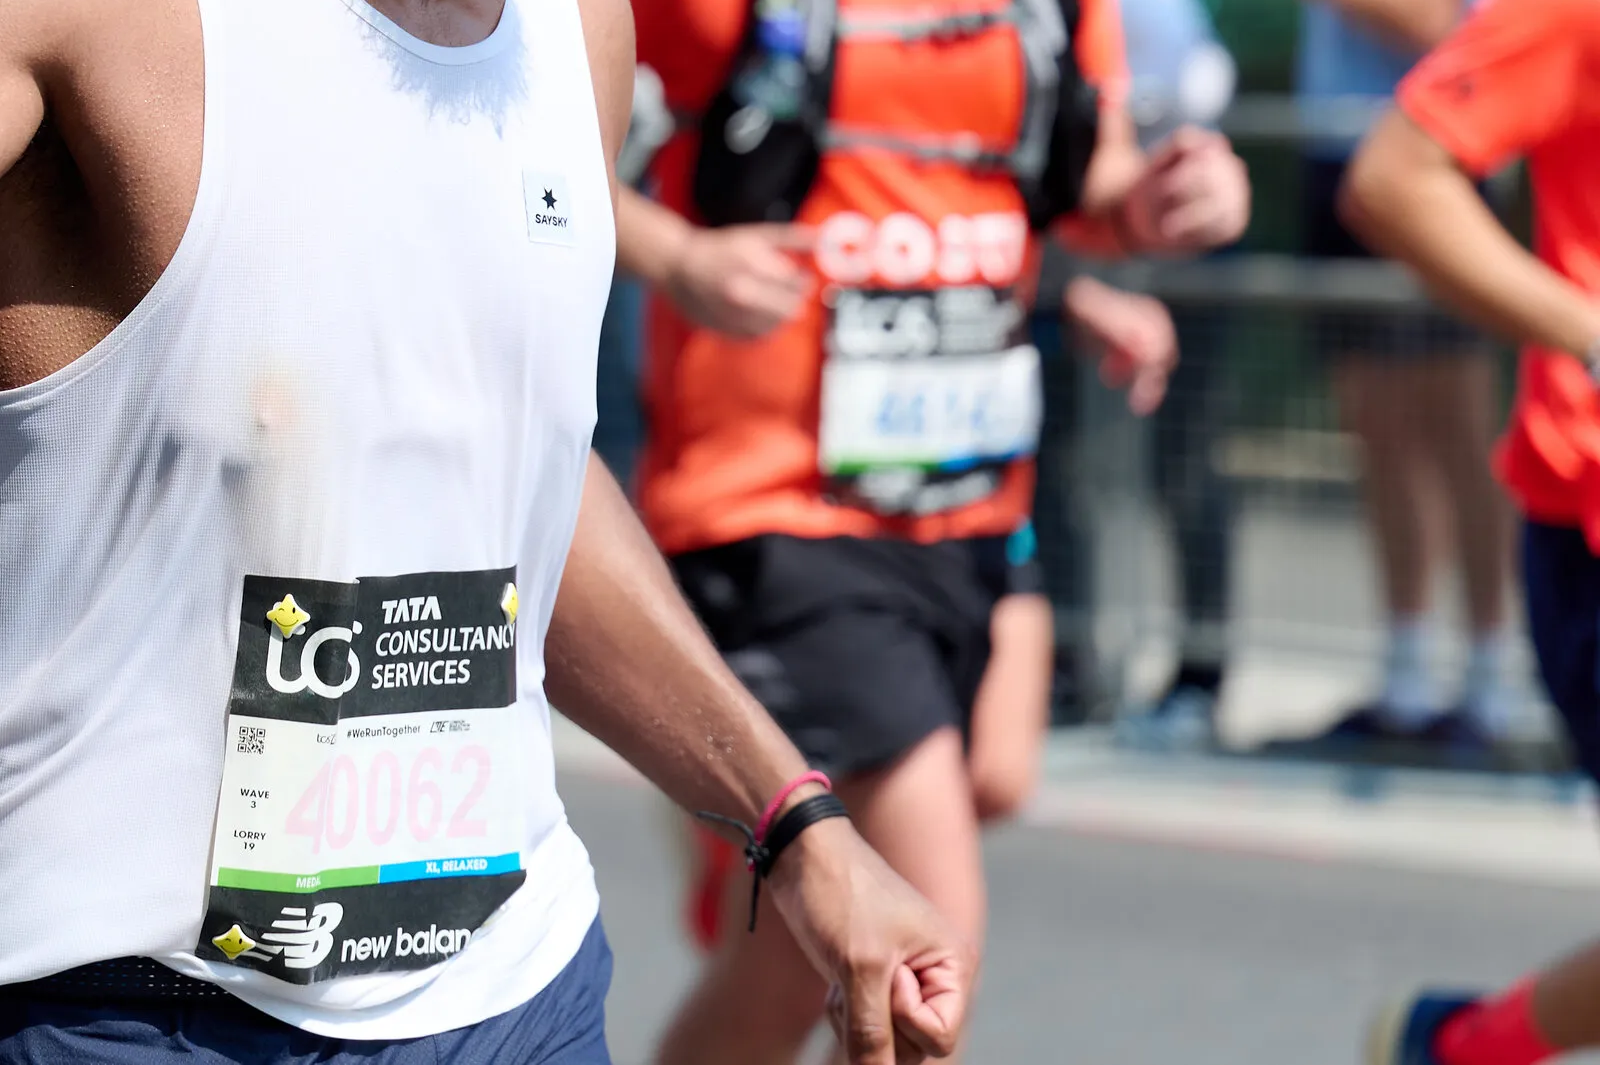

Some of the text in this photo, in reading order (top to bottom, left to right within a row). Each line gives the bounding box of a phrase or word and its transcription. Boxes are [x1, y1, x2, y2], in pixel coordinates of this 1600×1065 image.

[535, 214, 568, 228] SAYSKY
[382, 596, 442, 624] TATA
[375, 622, 516, 657] CONSULTANCY
[371, 659, 471, 689] SERVICES
[347, 724, 421, 738] #WeRunTogether
[240, 788, 270, 799] WAVE
[285, 744, 491, 855] 40062
[251, 800, 257, 809] 3
[234, 829, 266, 840] LORRY
[244, 841, 256, 851] 19
[426, 858, 488, 874] XL, RELAXED
[341, 924, 475, 962] new balan
